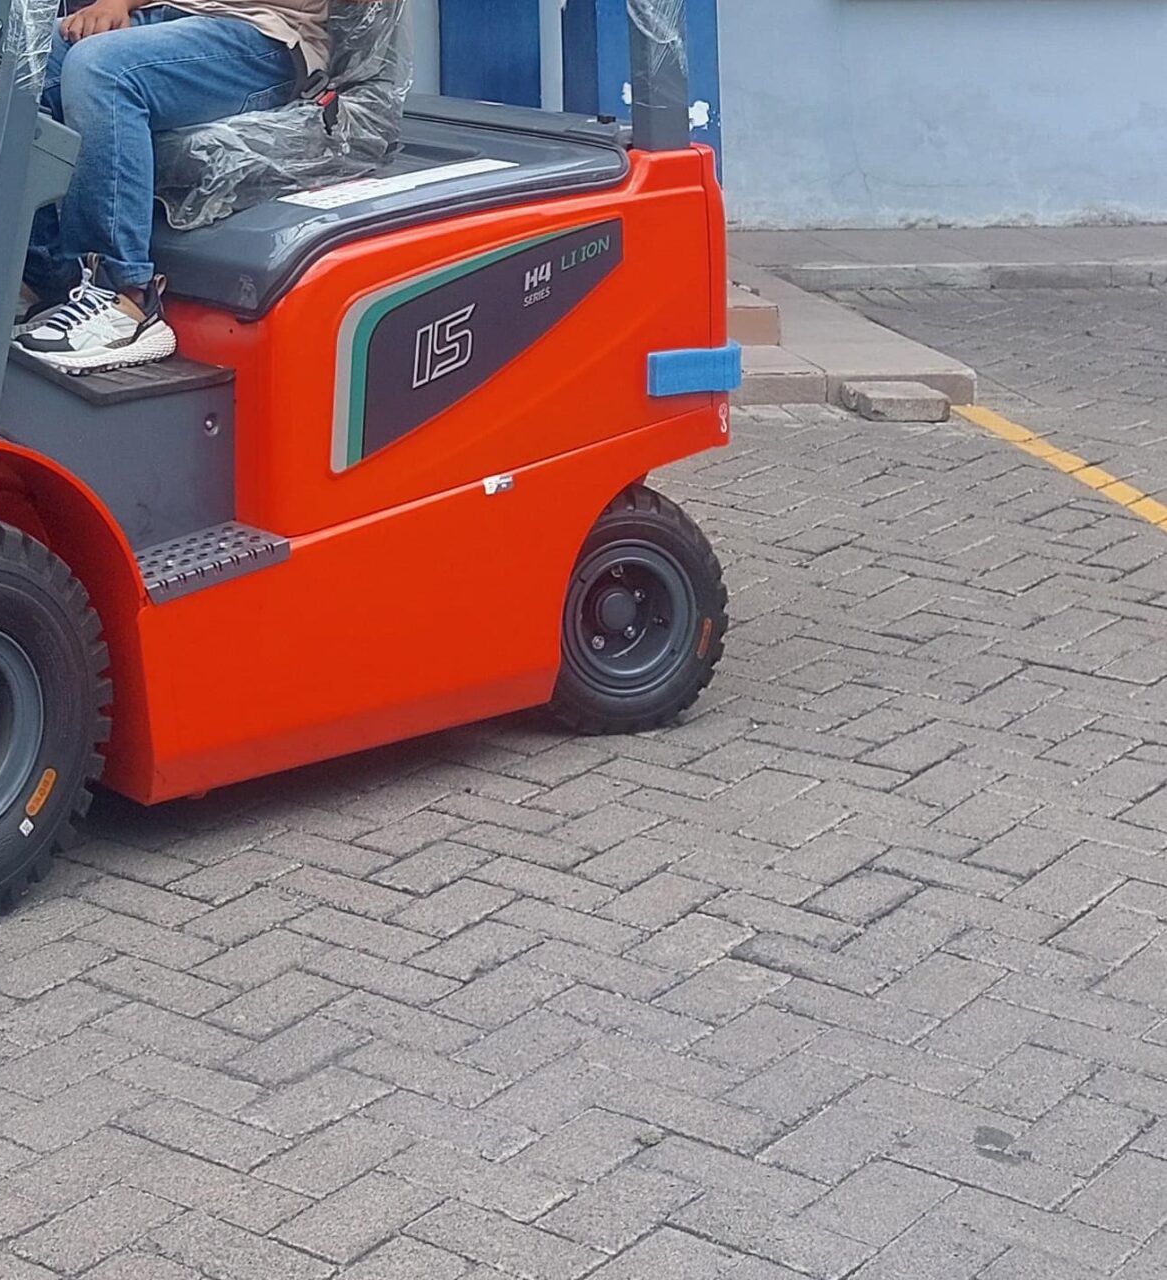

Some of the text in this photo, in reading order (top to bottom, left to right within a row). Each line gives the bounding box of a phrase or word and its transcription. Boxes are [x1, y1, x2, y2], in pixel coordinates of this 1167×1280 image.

[561, 234, 610, 271] LI ION
[524, 261, 551, 292] H4
[523, 286, 551, 308] SERIES
